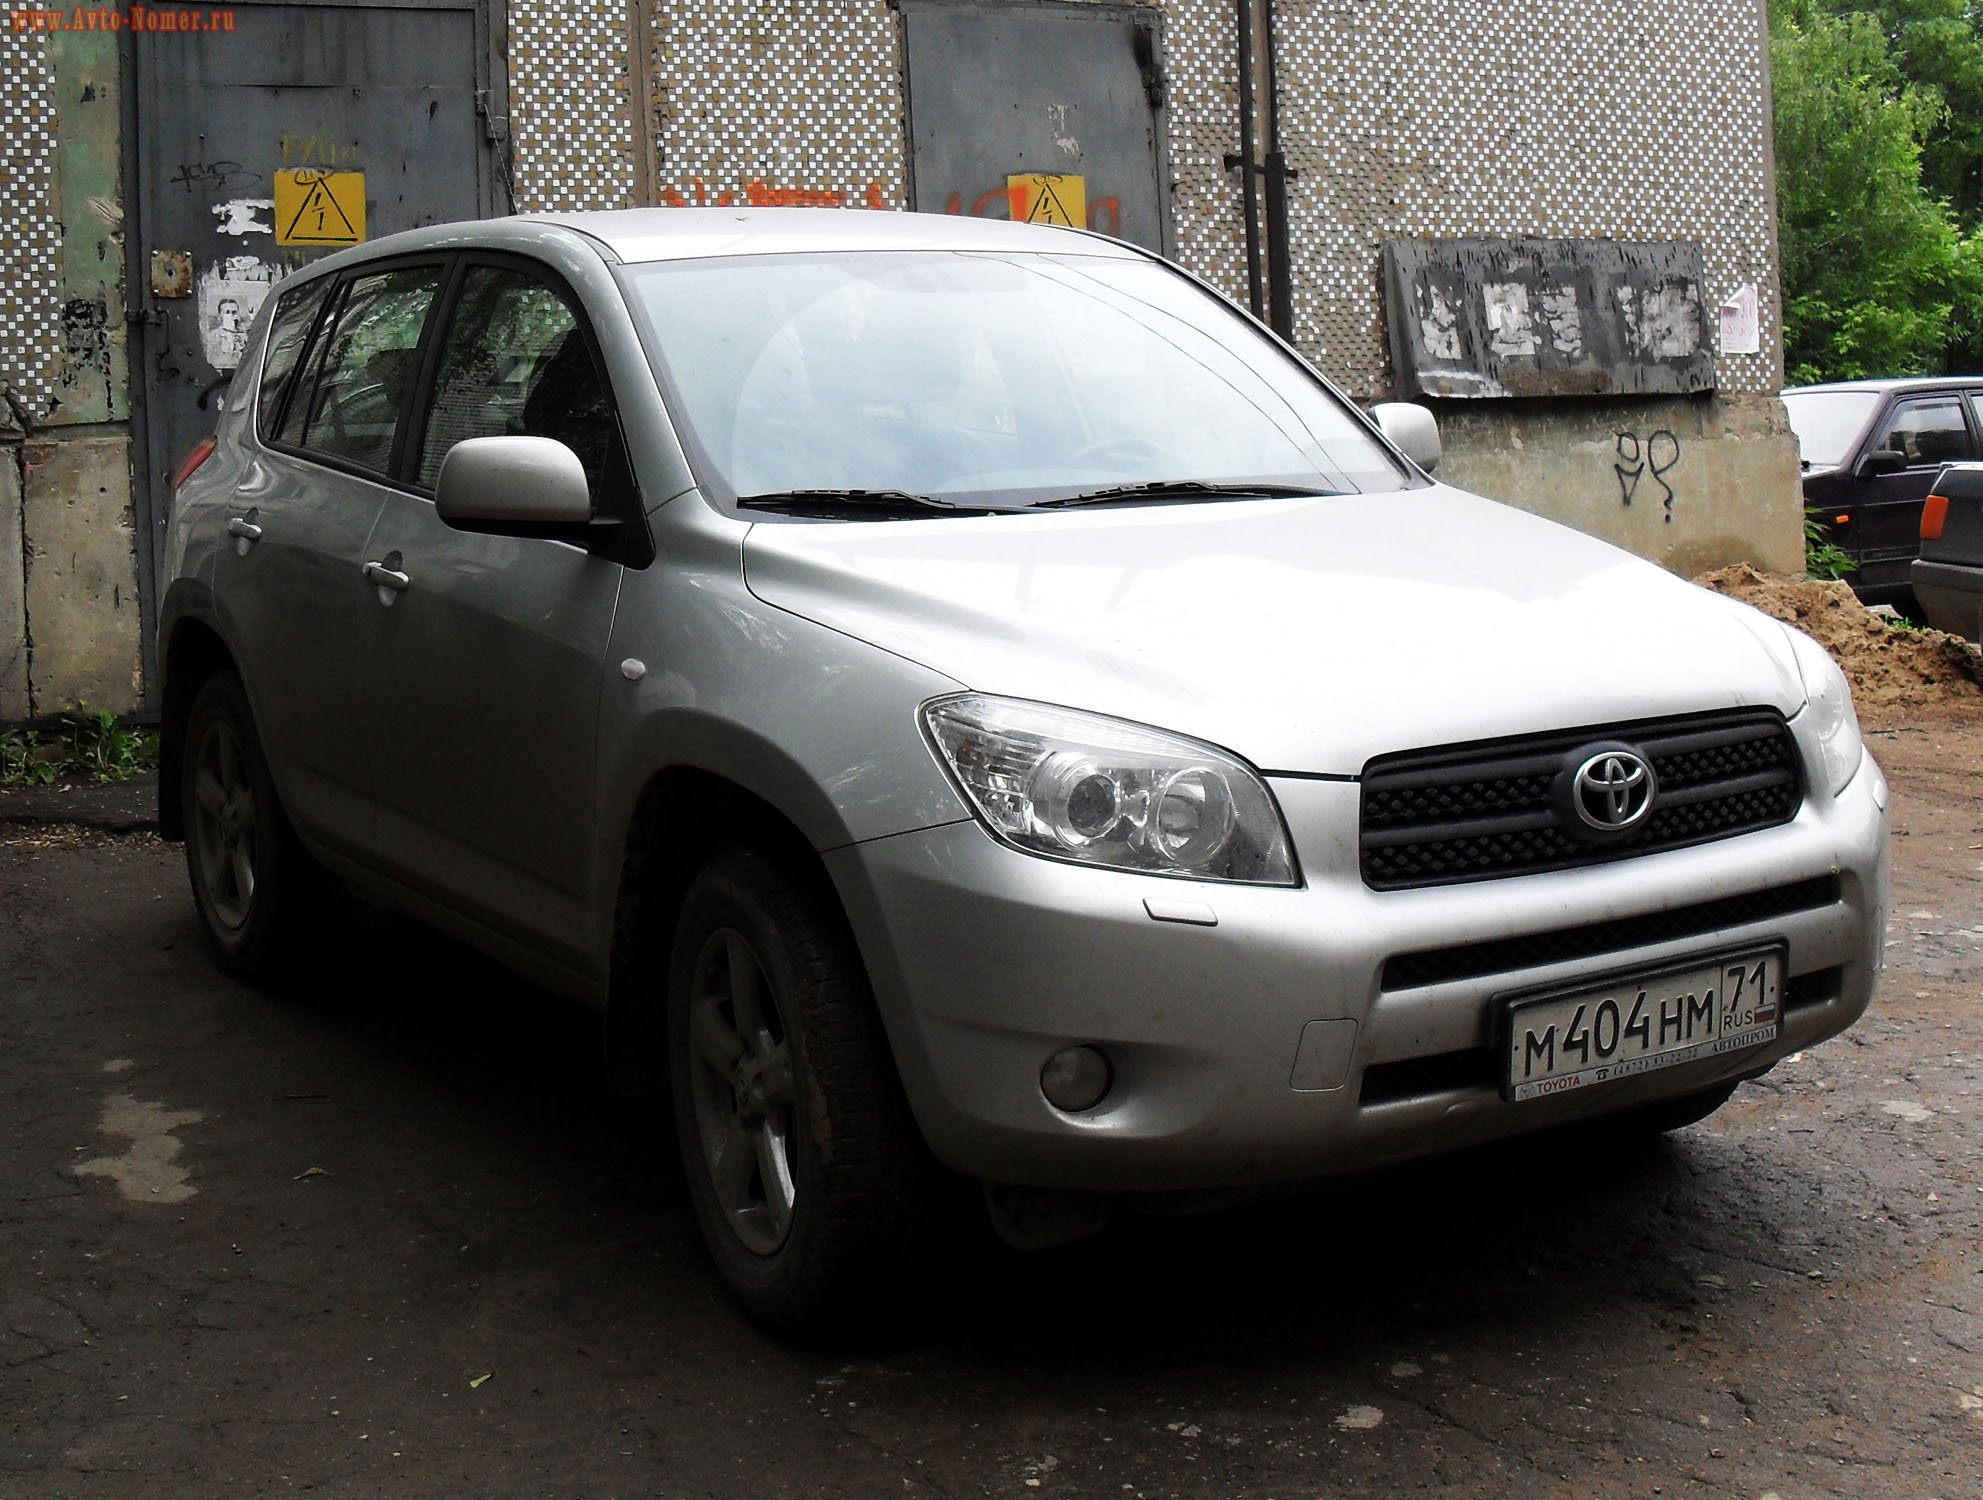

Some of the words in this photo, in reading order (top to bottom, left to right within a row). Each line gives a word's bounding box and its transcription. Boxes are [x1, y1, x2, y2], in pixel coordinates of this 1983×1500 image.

[1523, 988, 1715, 1078] М404НМ
[1726, 960, 1767, 1014] 71
[1722, 1009, 1754, 1032] RUS
[1536, 1075, 1581, 1095] TOYOTA
[1710, 1027, 1775, 1054] АВТОПРОМ
